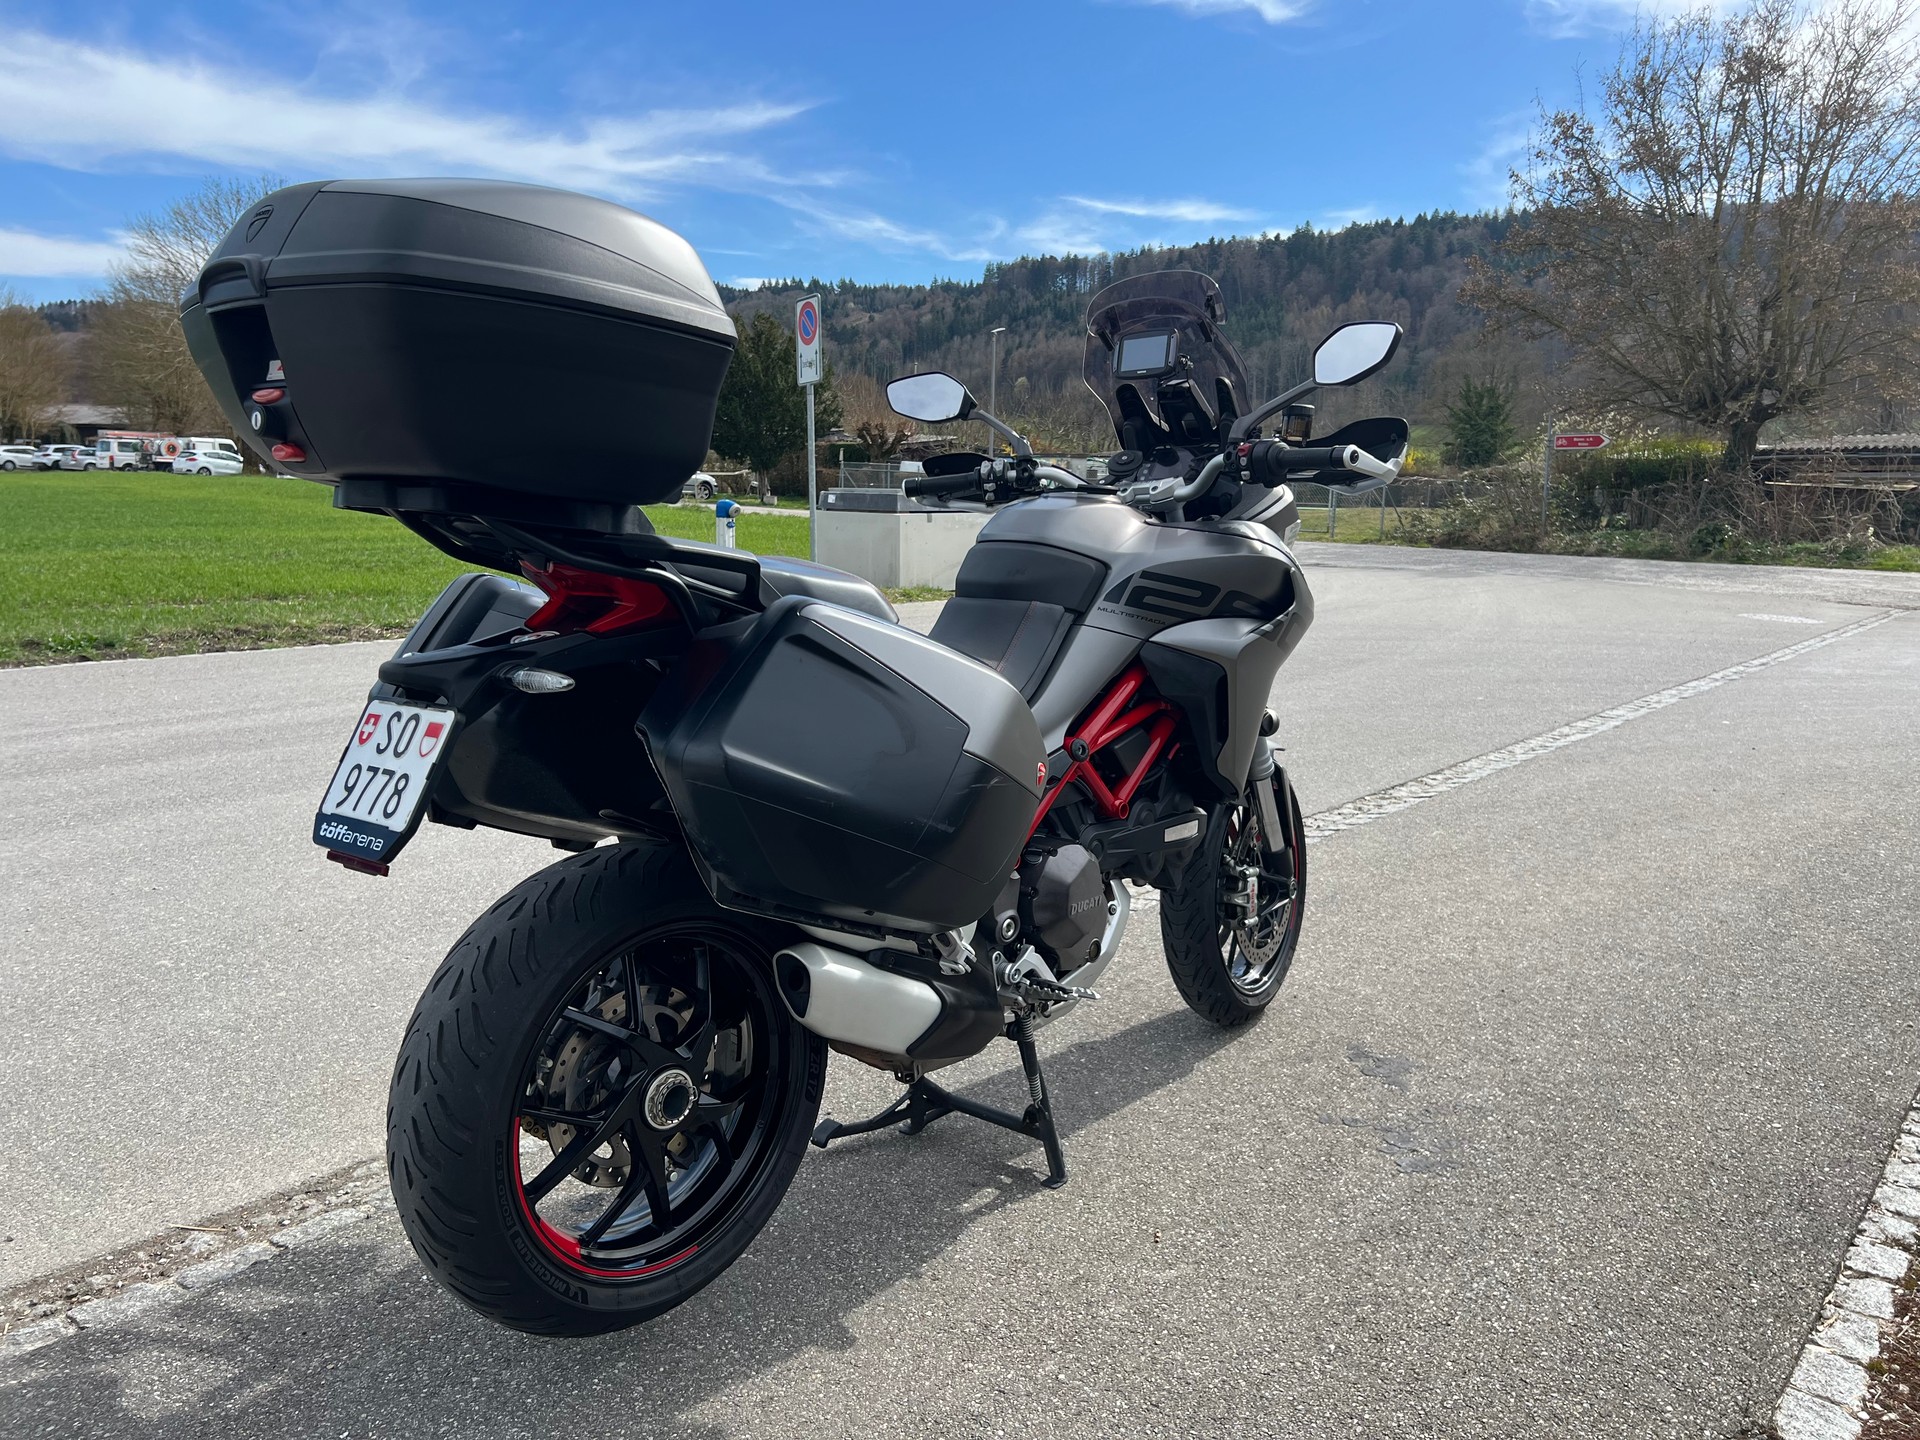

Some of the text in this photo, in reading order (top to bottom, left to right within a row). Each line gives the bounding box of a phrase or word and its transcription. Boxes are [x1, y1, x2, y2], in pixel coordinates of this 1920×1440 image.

[1097, 606, 1167, 626] MULTISTRADA
[376, 710, 421, 759] SO
[335, 763, 410, 819] 9778
[319, 821, 384, 851] töffarena
[1071, 895, 1103, 916] DUCATI
[499, 1185, 515, 1229] ROAD
[513, 1235, 567, 1294] MICHELIN
